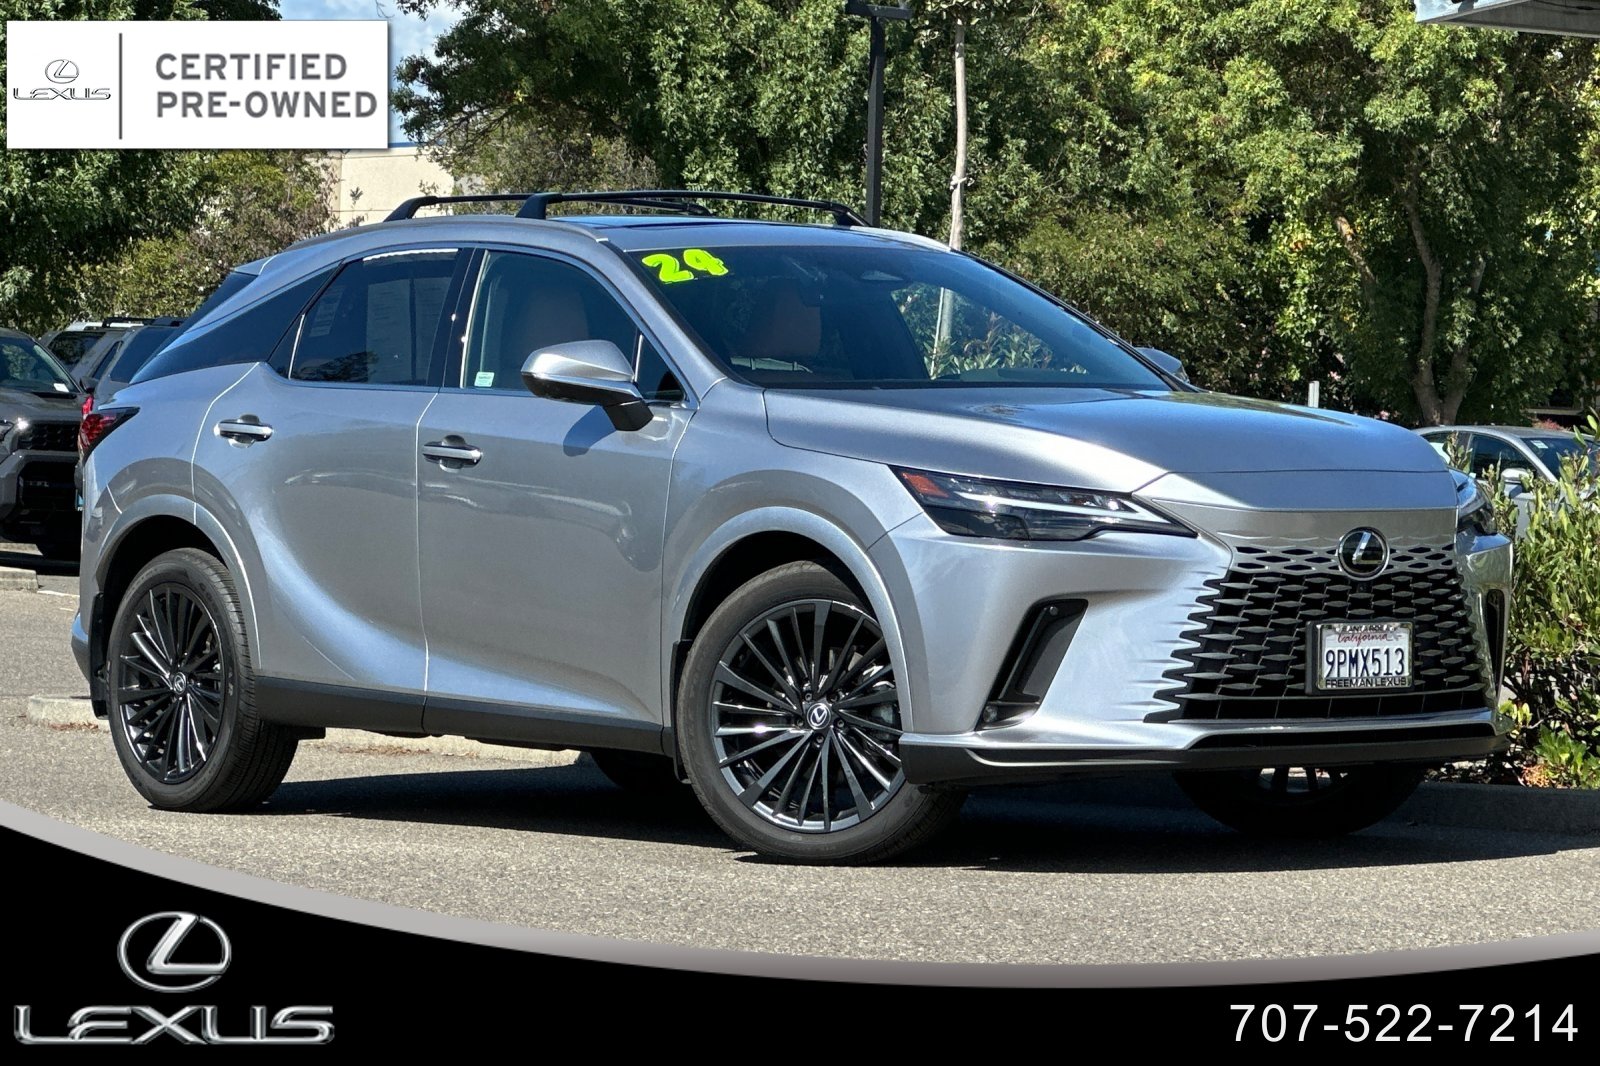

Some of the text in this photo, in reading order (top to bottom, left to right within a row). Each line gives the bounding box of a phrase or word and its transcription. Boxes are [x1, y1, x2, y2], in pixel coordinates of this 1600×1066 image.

[641, 248, 729, 284] 24
[1338, 631, 1391, 645] California
[1325, 647, 1405, 679] 9PMX513
[1325, 677, 1406, 688] FREEMAN LEXUS
